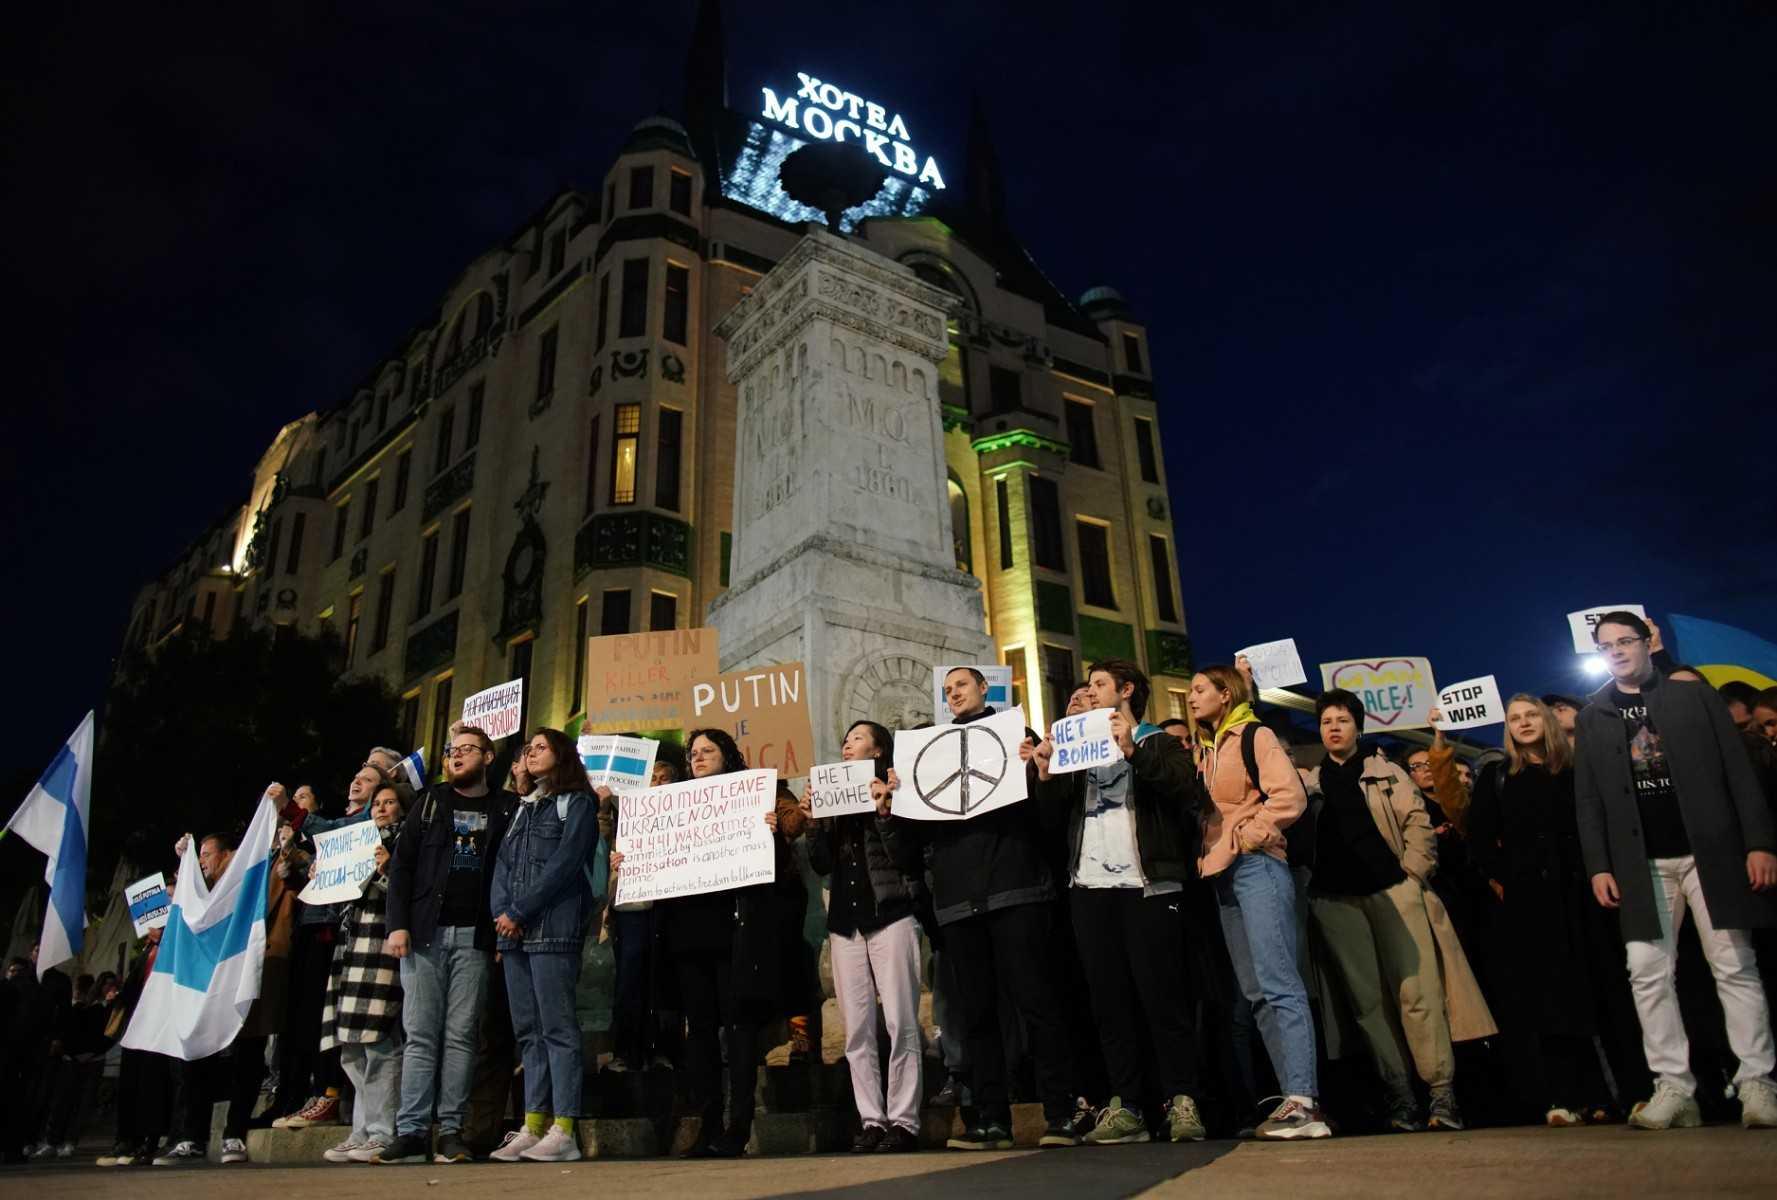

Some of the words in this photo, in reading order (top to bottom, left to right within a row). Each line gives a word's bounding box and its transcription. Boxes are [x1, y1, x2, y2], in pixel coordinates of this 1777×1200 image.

[797, 72, 911, 141] ХОТЕЛ
[761, 87, 946, 190] МОСКВА
[613, 630, 702, 662] PUTIN
[693, 670, 799, 716] PUTIN
[1441, 685, 1483, 705] STOP
[1448, 704, 1487, 723] WAR
[1055, 717, 1087, 744] НЕТ
[746, 739, 800, 775] ICA
[1058, 739, 1110, 767] ВОЙНЕ
[720, 776, 767, 799] LEAVE
[817, 764, 857, 785] НЕТ
[811, 784, 869, 809] ВОЙНЕ
[620, 811, 685, 838] UKRAINE
[688, 801, 729, 824] NOW
[674, 829, 701, 848] WAR
